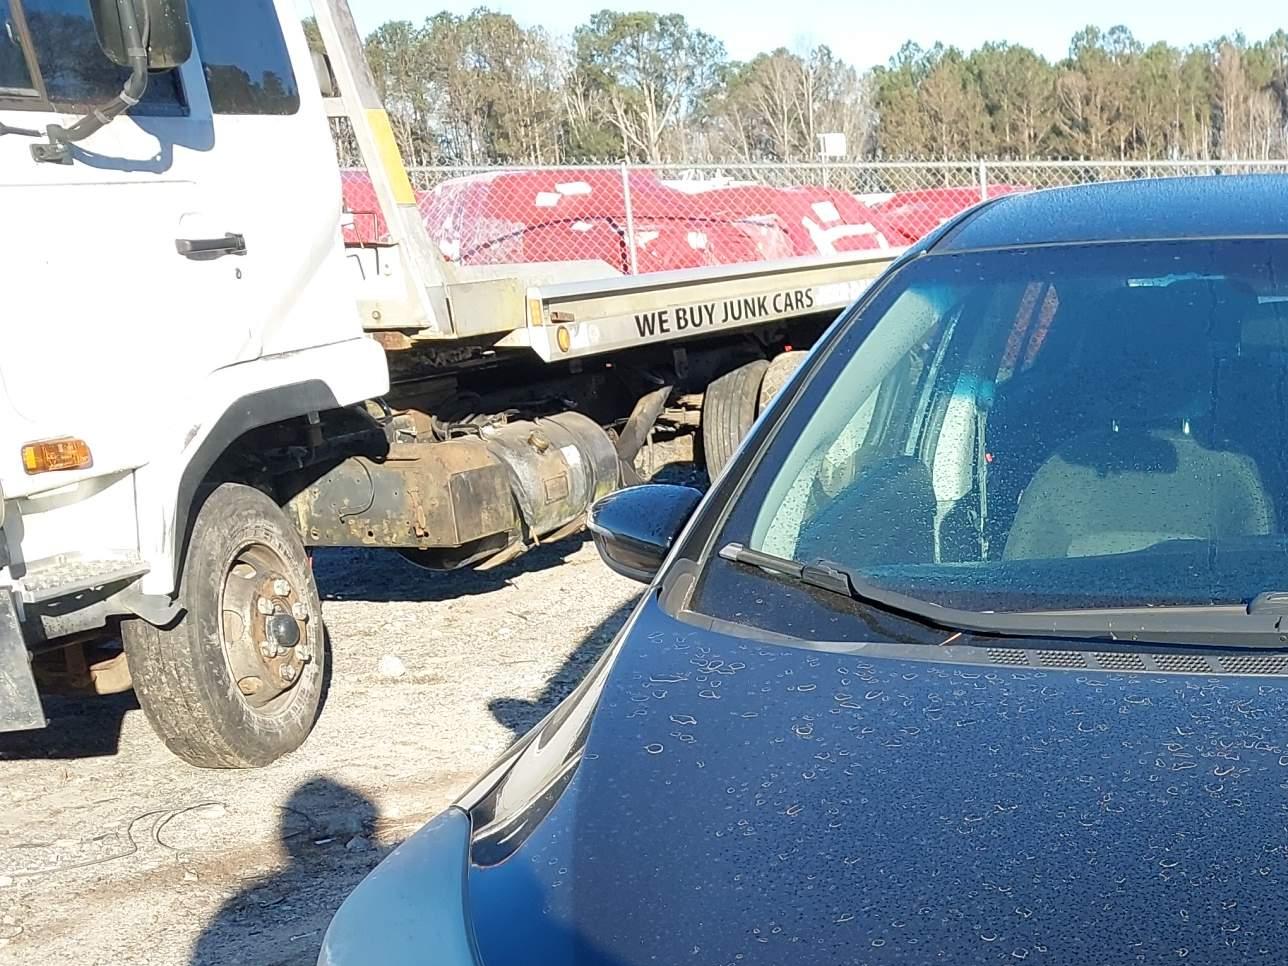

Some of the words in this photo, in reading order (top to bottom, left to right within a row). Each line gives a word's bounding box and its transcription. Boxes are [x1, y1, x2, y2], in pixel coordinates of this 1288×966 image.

[634, 310, 671, 338] WE
[675, 303, 716, 330] BUY
[721, 295, 769, 323] JUNK
[772, 288, 814, 314] CARS
